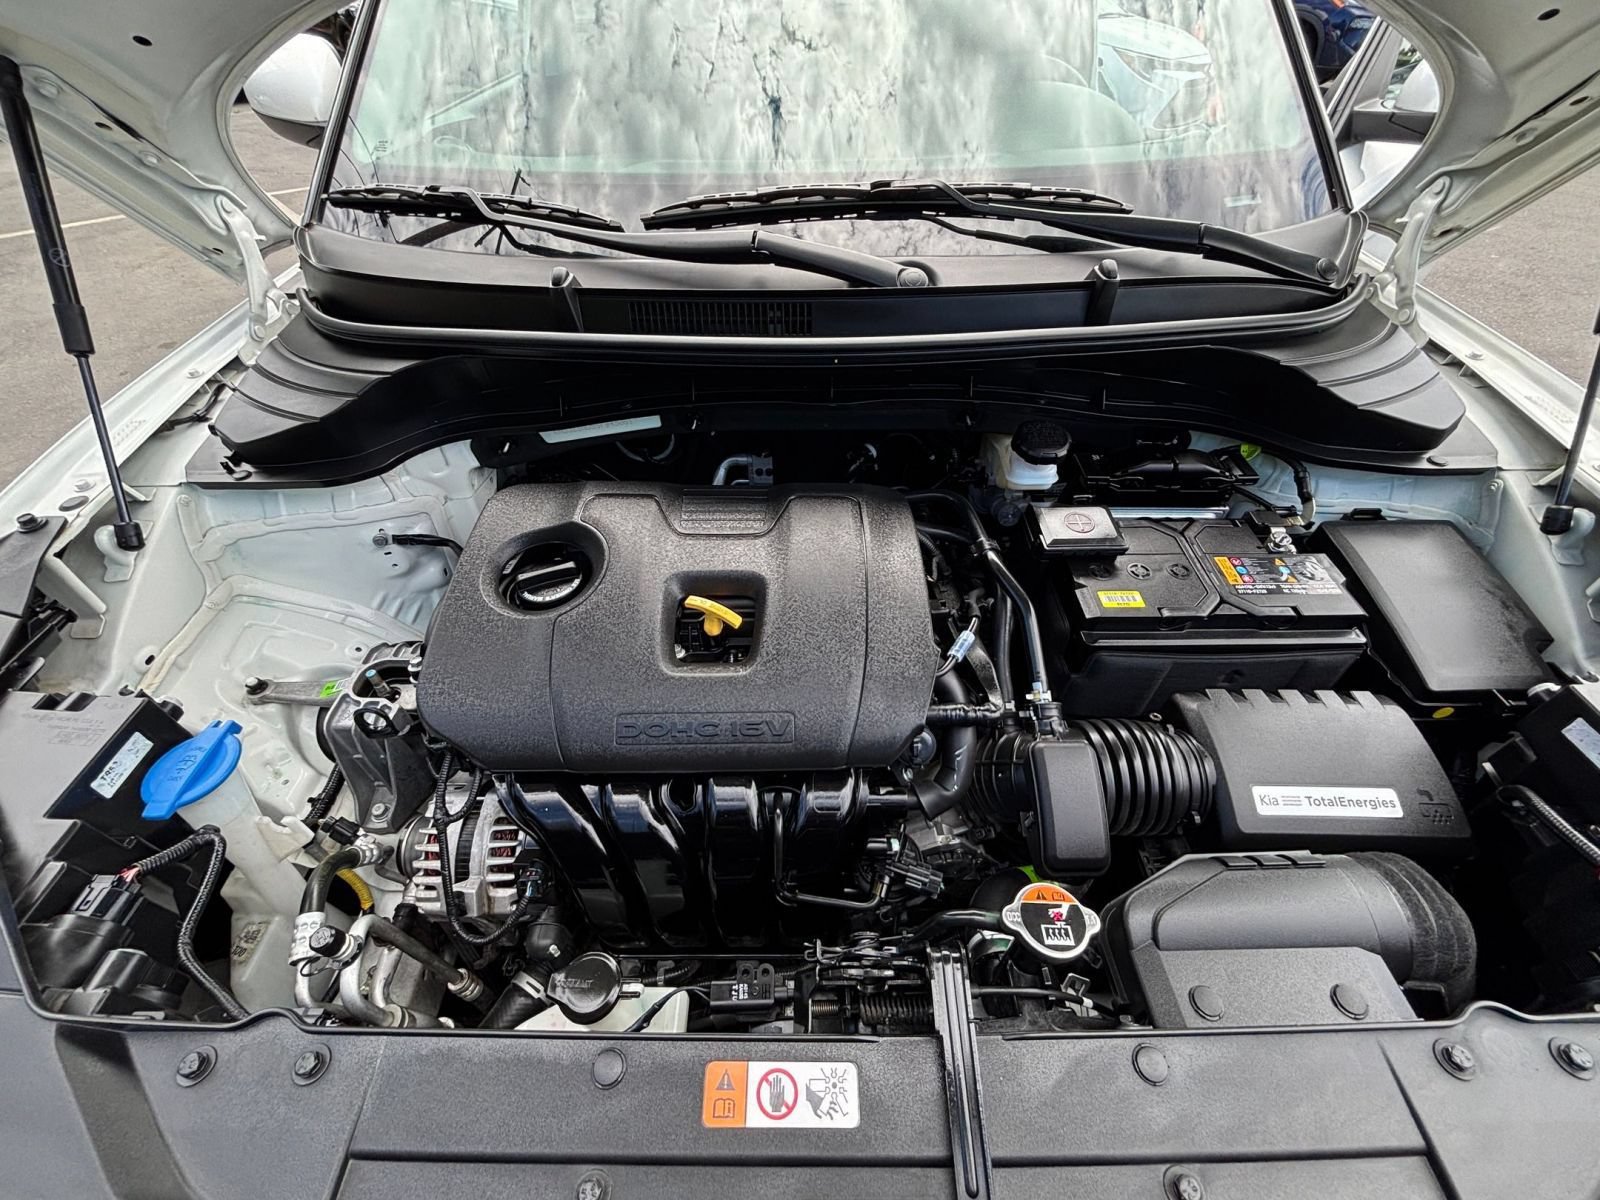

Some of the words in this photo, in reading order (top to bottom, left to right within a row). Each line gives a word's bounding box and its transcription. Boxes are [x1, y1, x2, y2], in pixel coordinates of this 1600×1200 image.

[616, 721, 721, 739] DOHC
[730, 720, 791, 737] 16V
[1259, 795, 1279, 806] Kia
[1304, 796, 1397, 810] TotalEnergies
